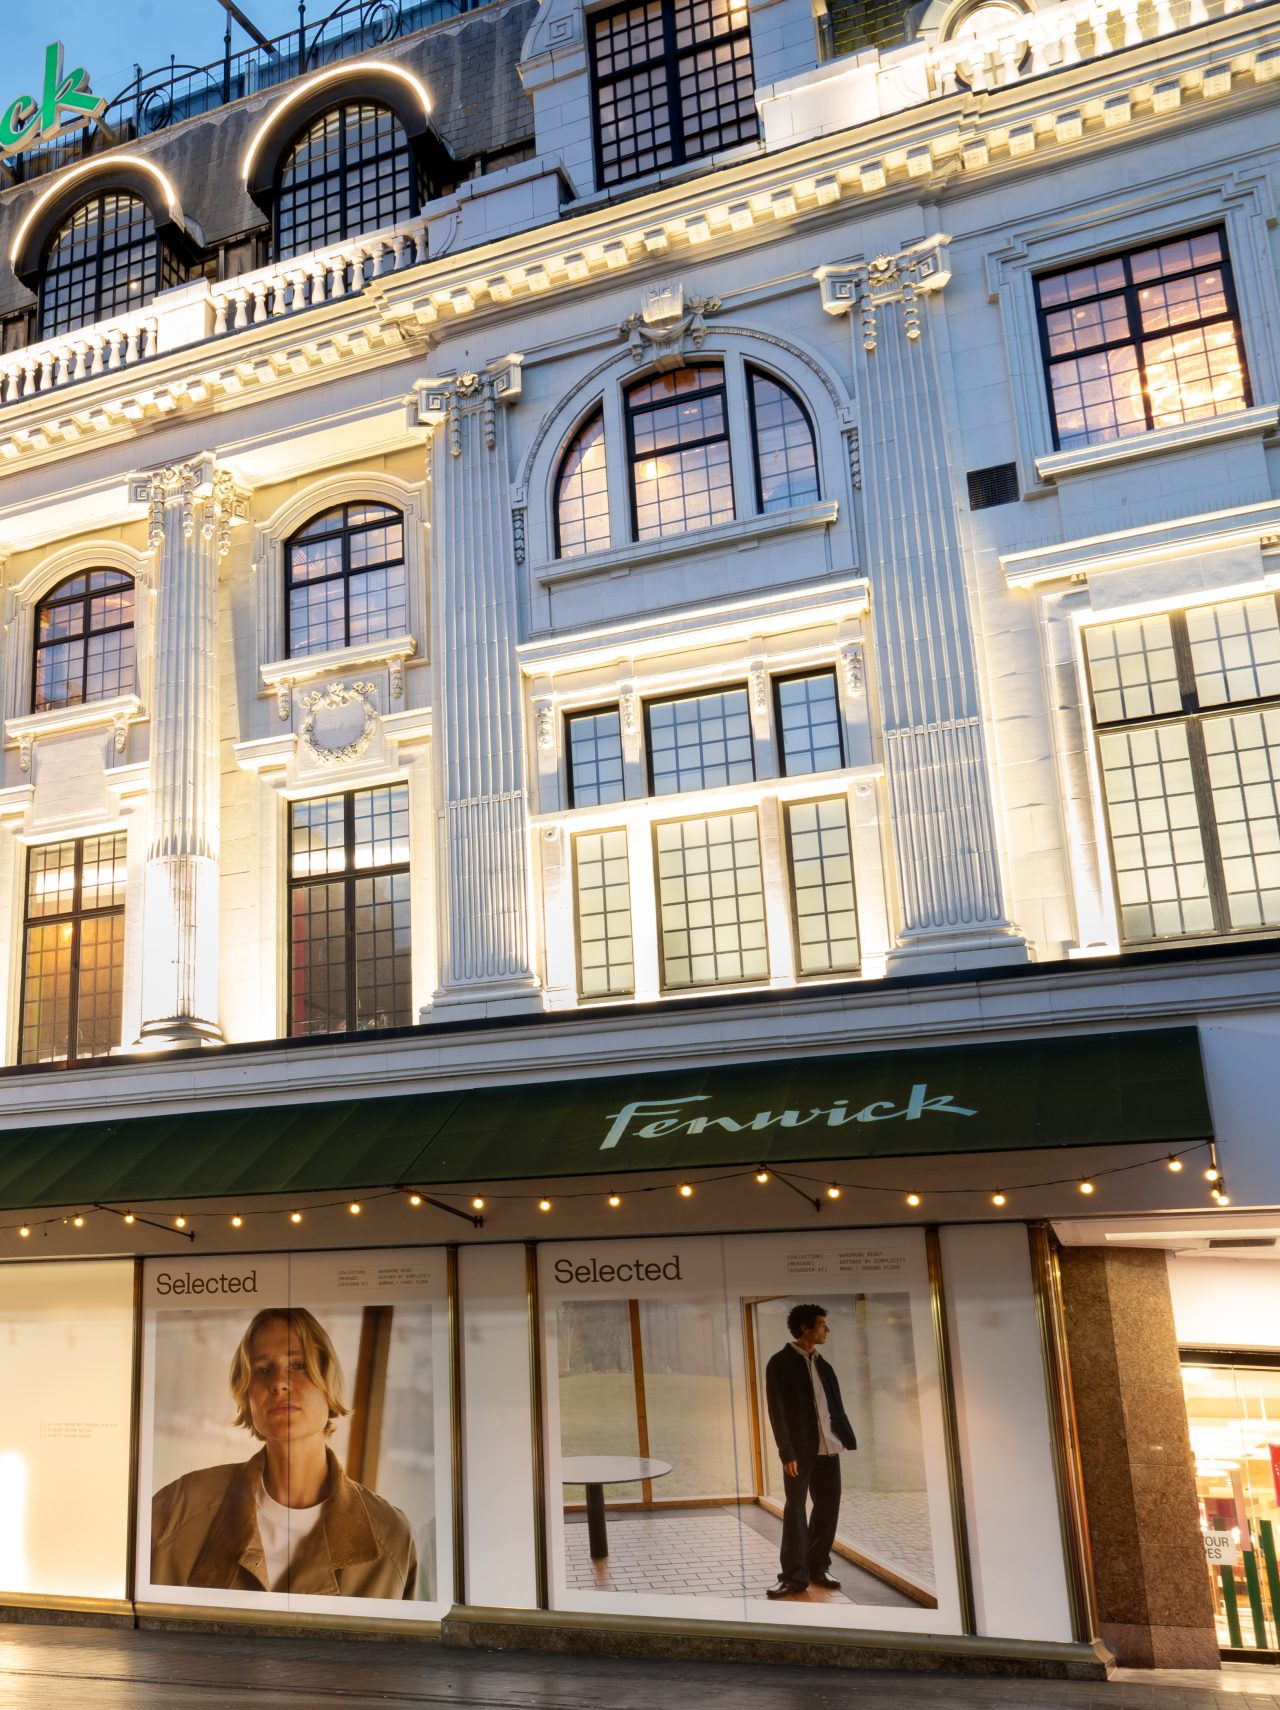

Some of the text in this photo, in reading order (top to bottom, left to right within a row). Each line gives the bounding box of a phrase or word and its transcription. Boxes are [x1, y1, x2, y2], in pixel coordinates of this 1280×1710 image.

[599, 1083, 978, 1150] Fenwick
[156, 1270, 258, 1295] Selected
[554, 1255, 683, 1284] Selected
